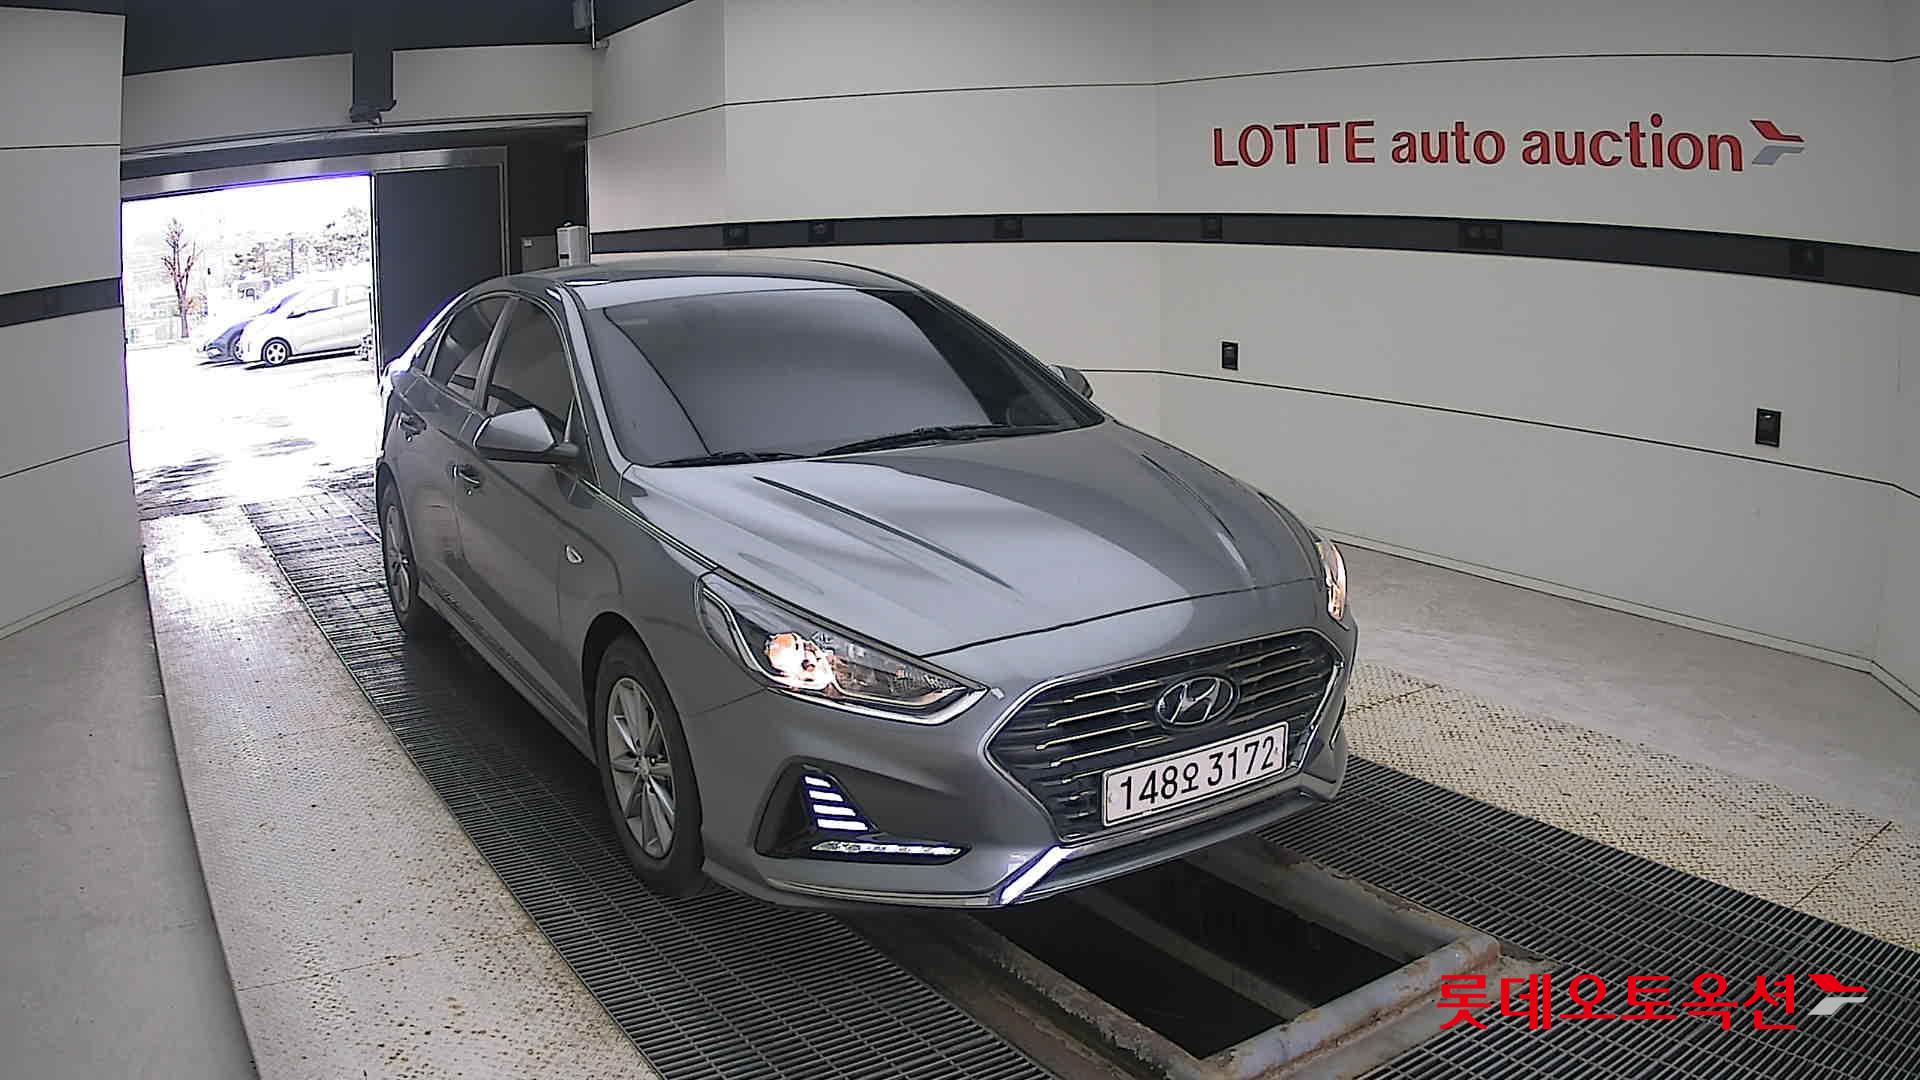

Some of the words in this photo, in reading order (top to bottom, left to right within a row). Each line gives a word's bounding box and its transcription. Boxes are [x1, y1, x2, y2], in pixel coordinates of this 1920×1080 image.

[1213, 120, 1375, 167] LOTTE
[1391, 121, 1505, 165] auto
[1521, 113, 1744, 171] auction
[1120, 762, 1199, 810] 148오
[1208, 736, 1275, 787] 3172
